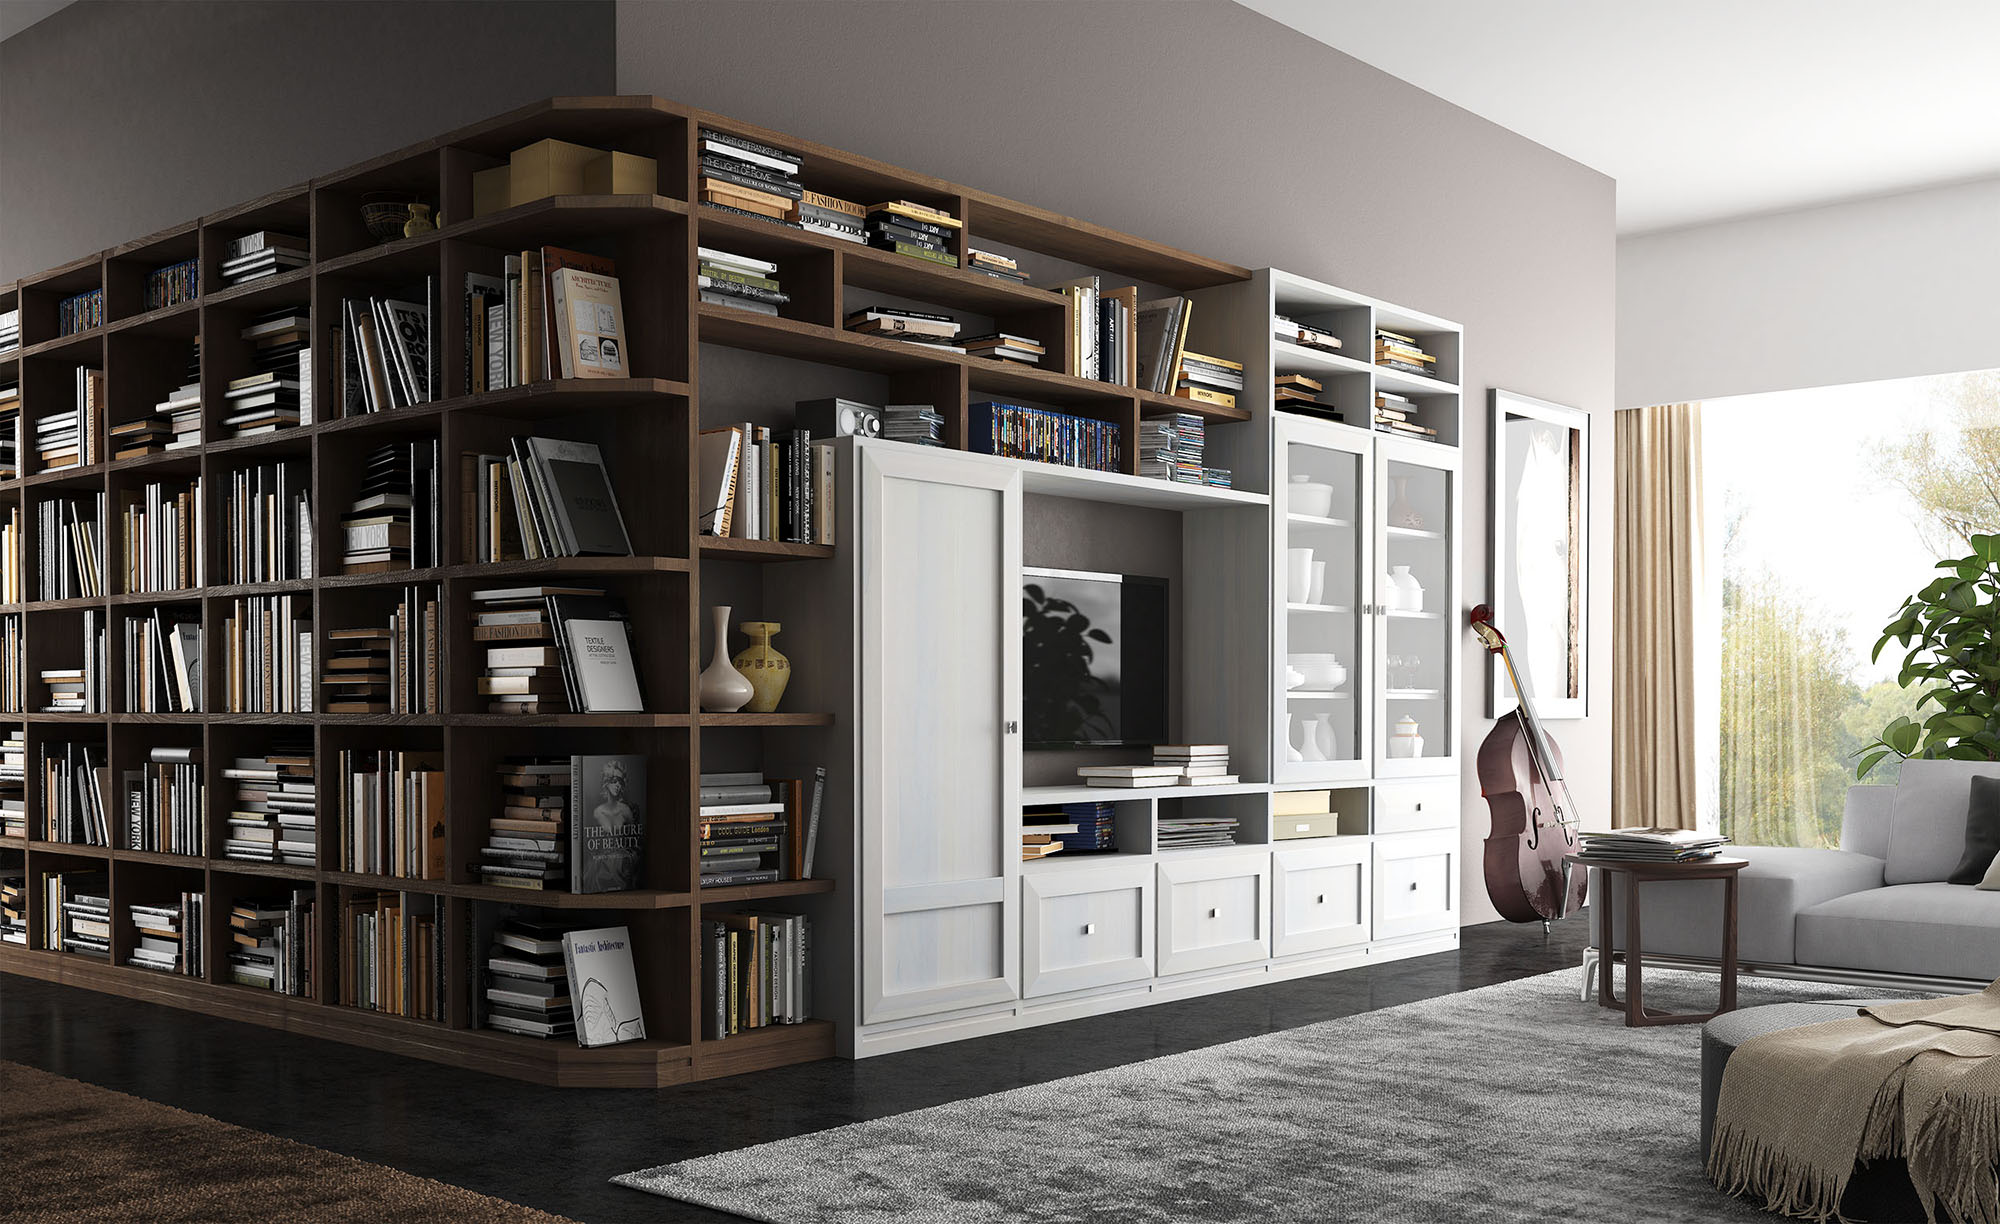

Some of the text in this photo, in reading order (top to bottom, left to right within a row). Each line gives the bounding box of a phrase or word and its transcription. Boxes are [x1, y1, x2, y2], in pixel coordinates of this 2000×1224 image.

[705, 130, 718, 142] THE
[705, 157, 718, 168] THE
[811, 193, 843, 211] FASHION
[489, 306, 504, 391] NEW YORK
[490, 626, 519, 639] FASHION
[585, 637, 604, 645] TEXTILE
[587, 645, 615, 653] DESIGNERS
[301, 633, 311, 710] NEW YORK
[131, 793, 141, 849] NEW YORK
[584, 824, 643, 838] THE ALLURE
[751, 825, 769, 833] London
[587, 837, 640, 850] OF BEAUTY
[716, 996, 725, 1016] Design
